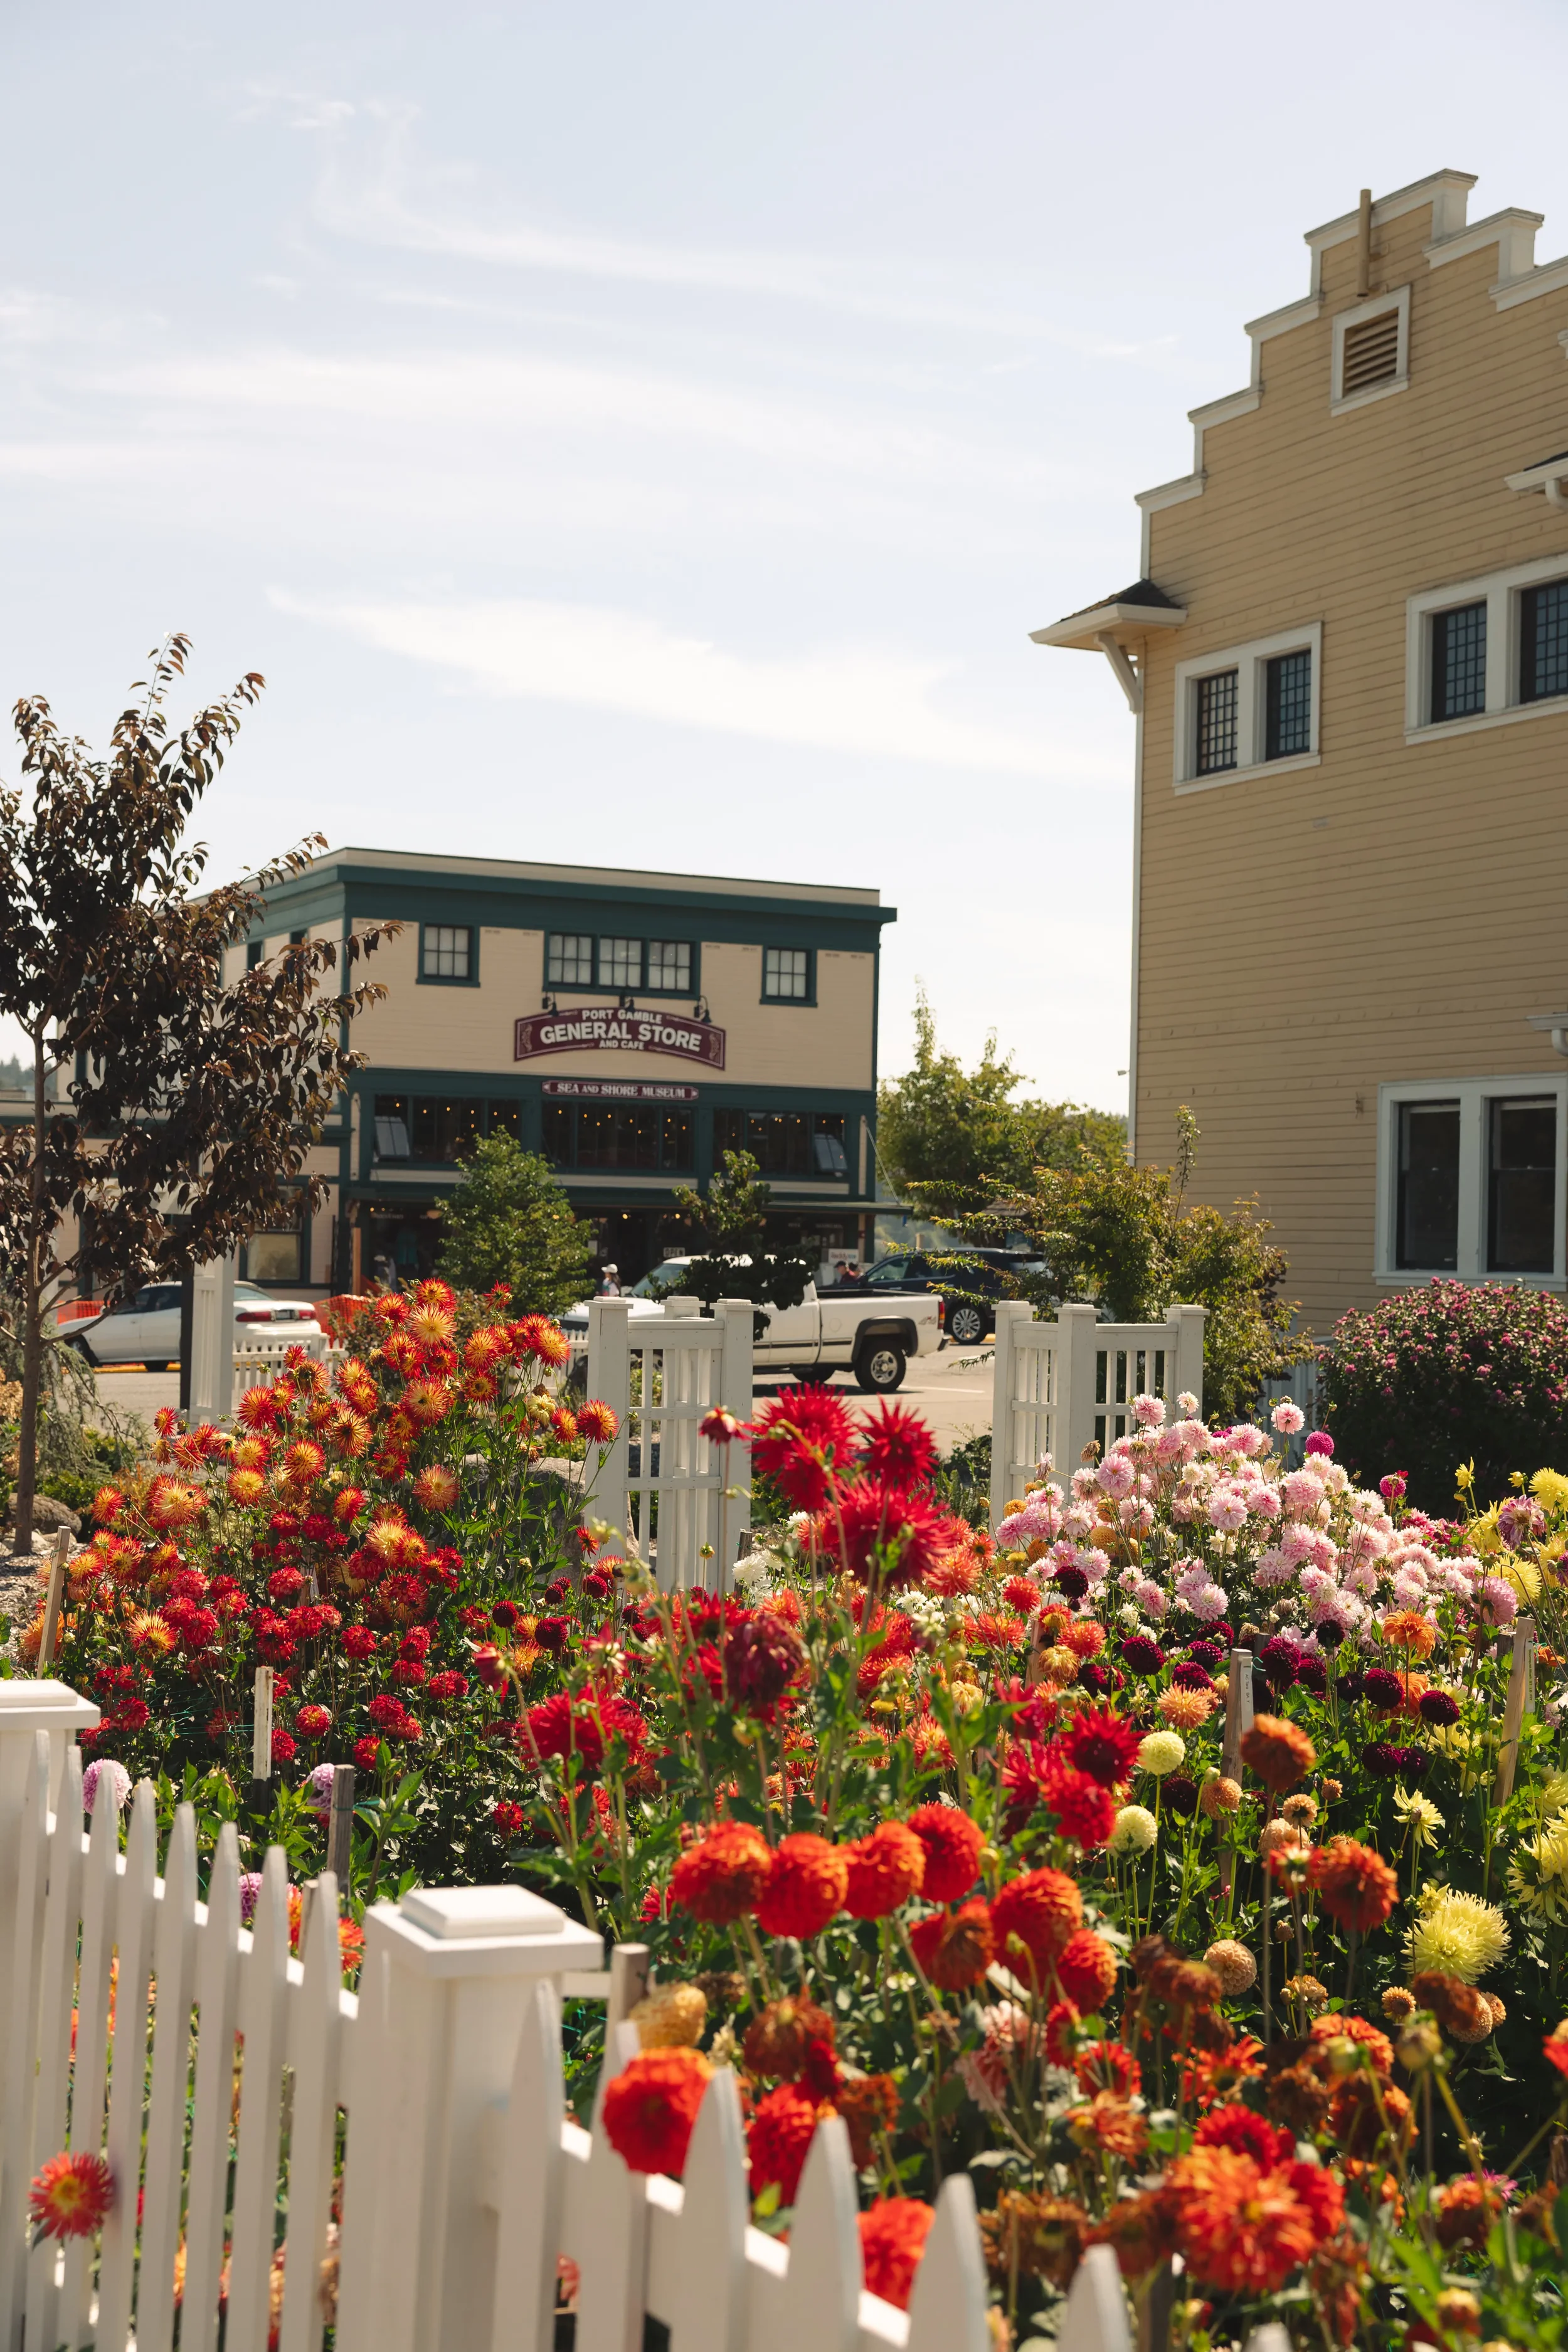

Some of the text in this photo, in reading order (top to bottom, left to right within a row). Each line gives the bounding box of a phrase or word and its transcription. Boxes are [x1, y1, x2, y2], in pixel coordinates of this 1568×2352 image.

[582, 1009, 662, 1024] PORT GAMBLE
[540, 1022, 702, 1052] GENERAL STORE
[599, 1039, 644, 1050] AND CAFE
[557, 1083, 685, 1098] SEA AND SHORE MUSEUM
